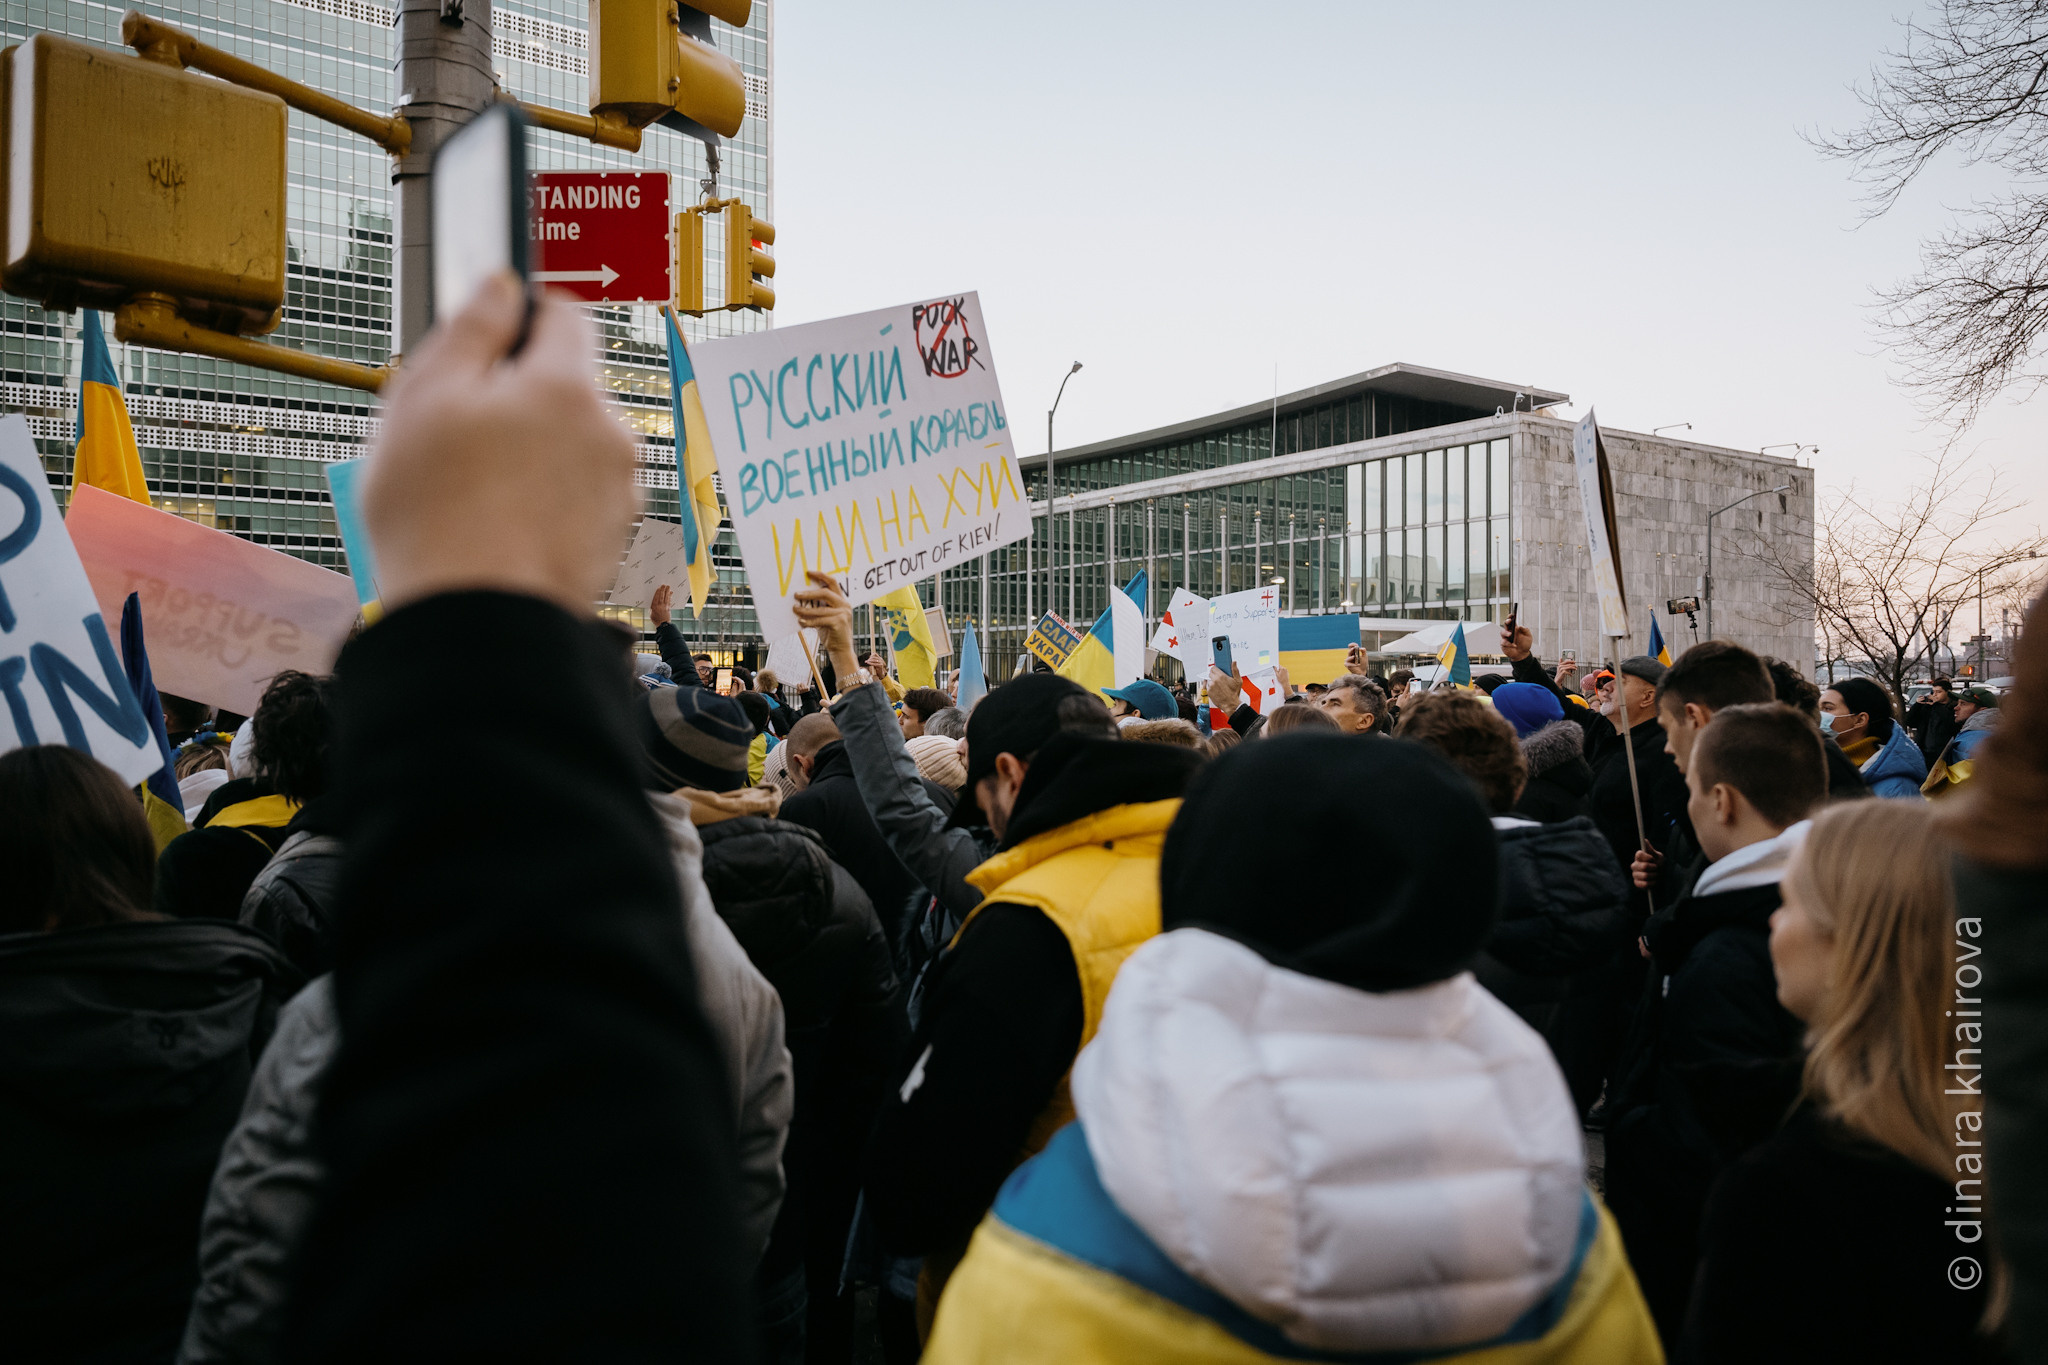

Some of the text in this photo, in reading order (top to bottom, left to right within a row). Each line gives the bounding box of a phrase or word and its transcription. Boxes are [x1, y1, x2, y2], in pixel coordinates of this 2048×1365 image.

[912, 296, 968, 331] FUCK
[921, 336, 986, 377] WAR
[729, 323, 907, 453] РУССКИЙ
[738, 400, 1006, 517] ВОЕННЫЙ КОРАБЛЬ
[771, 498, 875, 598] ИДИ
[876, 484, 931, 552] НА
[937, 442, 1020, 529] ХУЙ
[864, 512, 1000, 590] GET OUT OF KIEV!
[1244, 604, 1277, 621] Supports
[1029, 634, 1067, 668] УКРАЇ
[1041, 620, 1079, 654] СЛАВ
